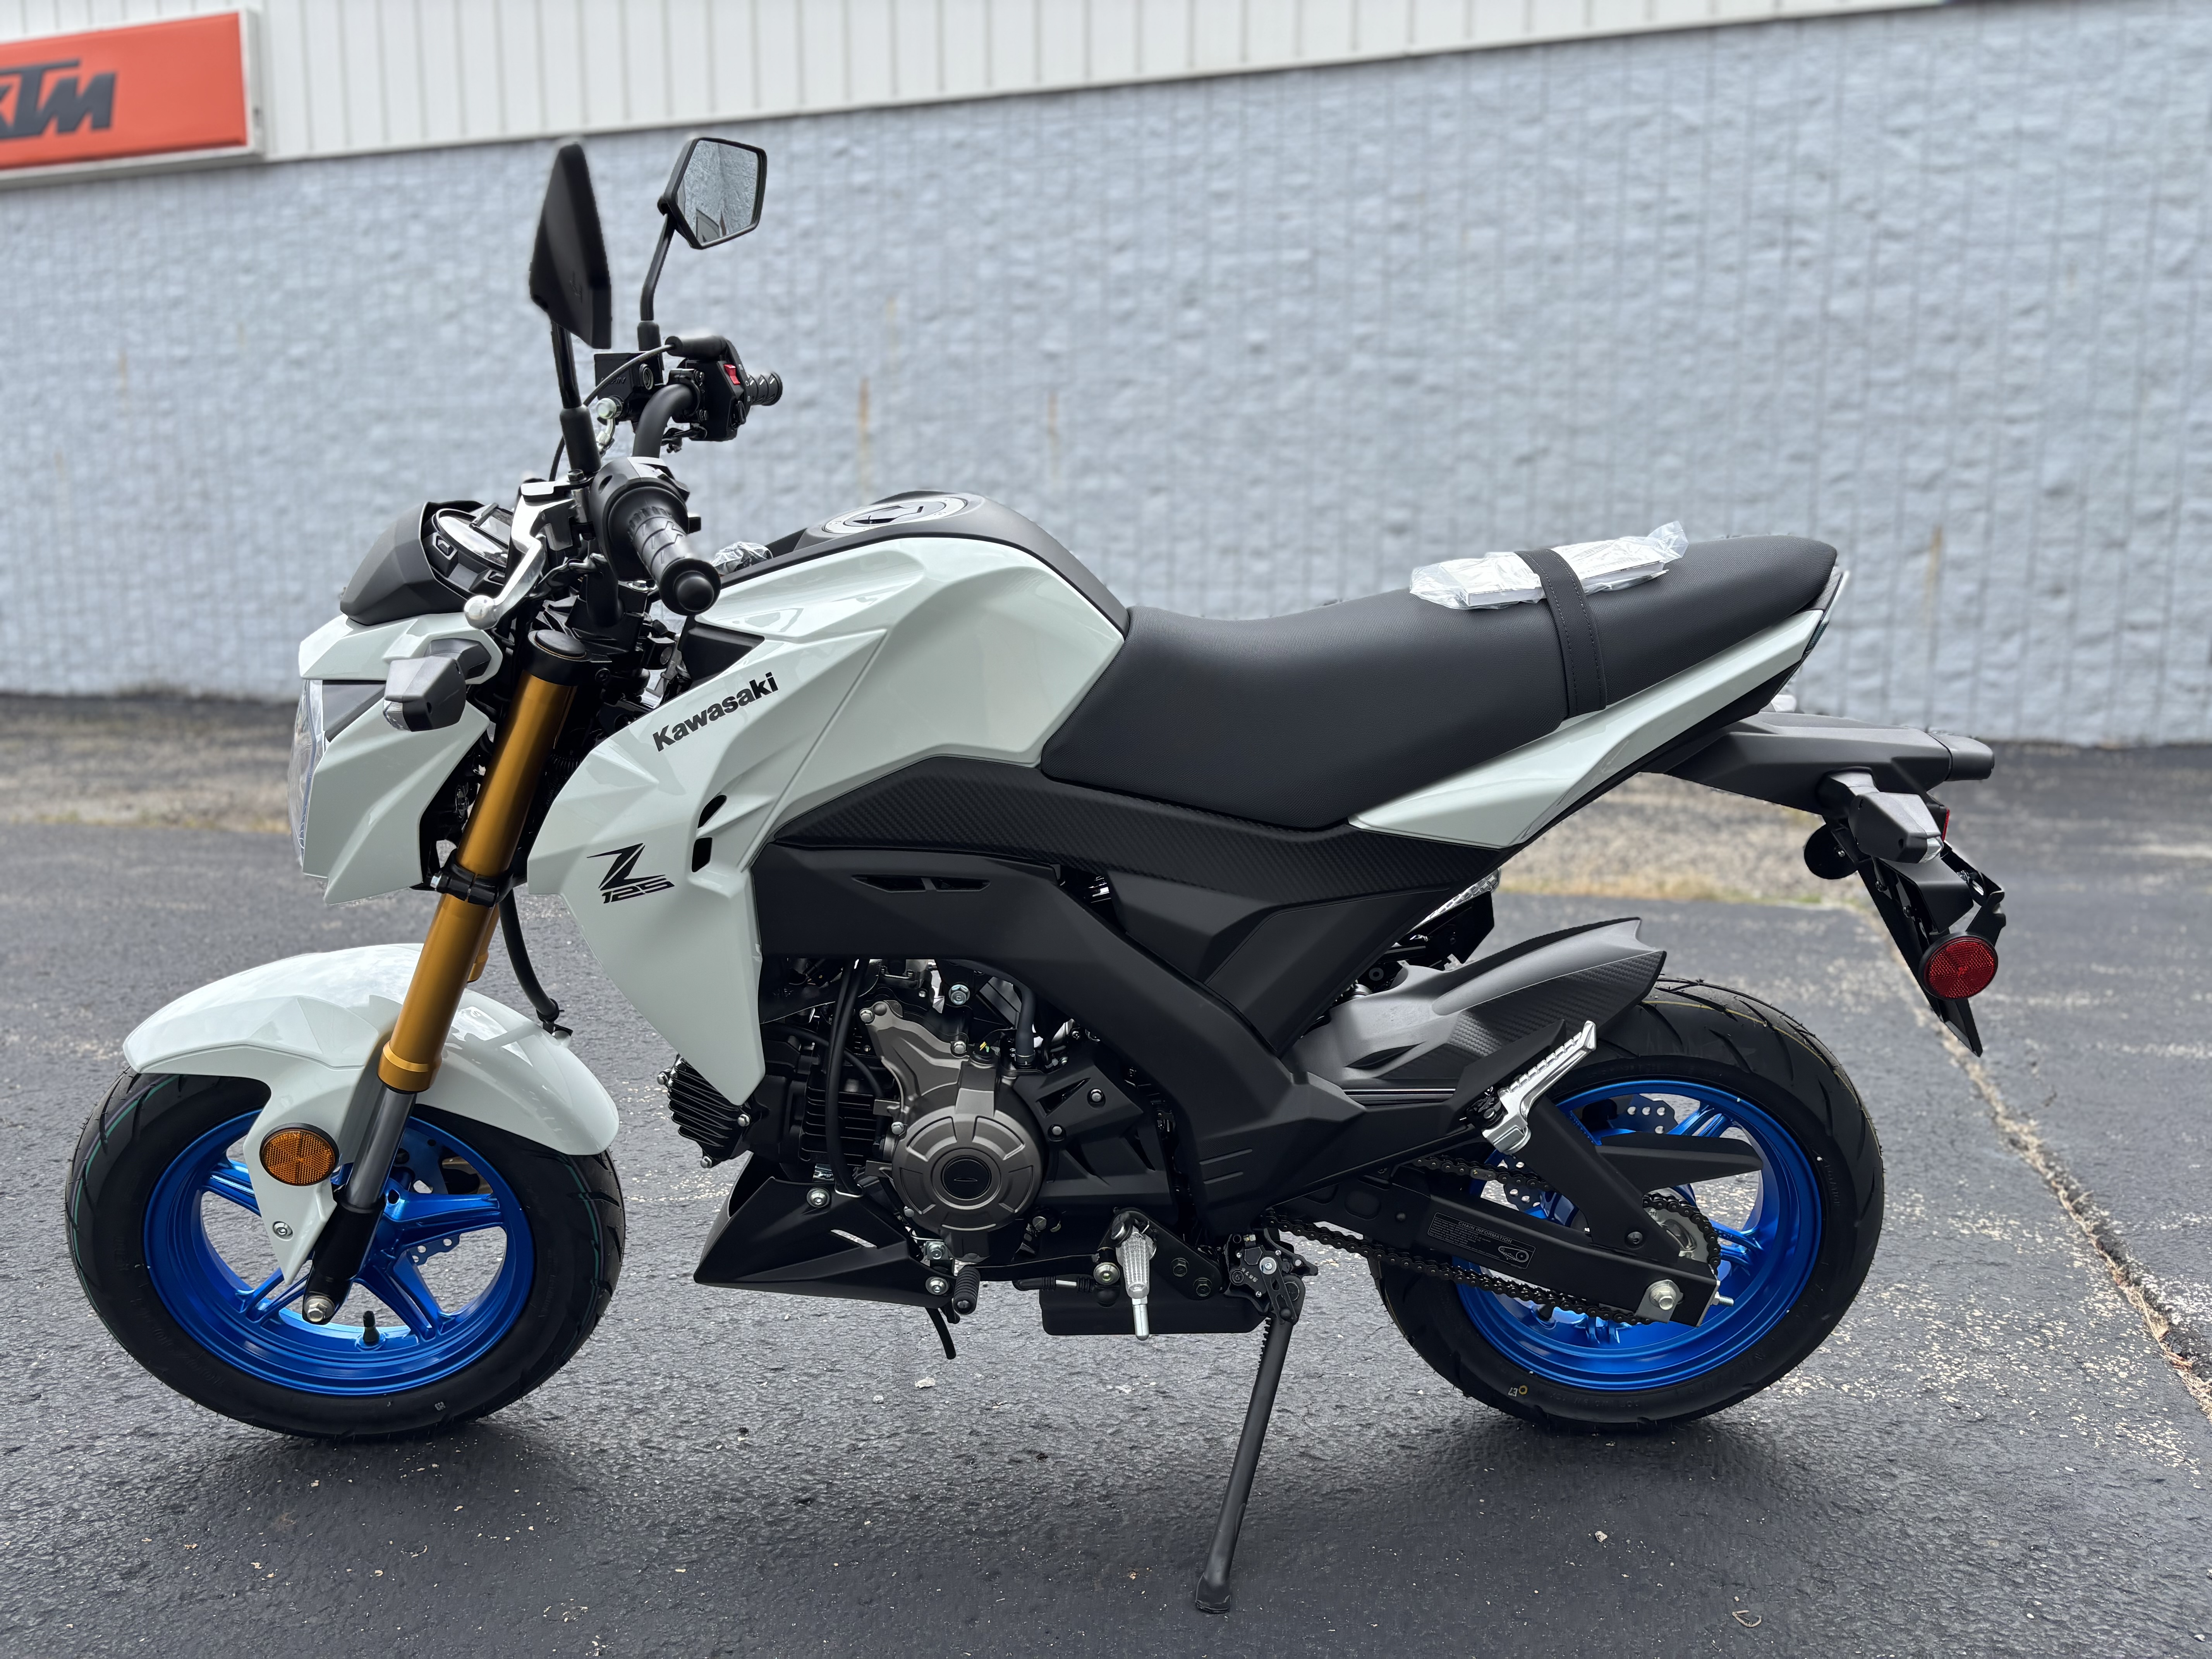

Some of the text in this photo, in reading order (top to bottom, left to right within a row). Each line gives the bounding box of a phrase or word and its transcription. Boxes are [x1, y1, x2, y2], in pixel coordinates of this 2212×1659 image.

[0, 58, 117, 140] TM
[653, 672, 778, 752] Kawasaki
[586, 843, 666, 890] Z
[601, 878, 675, 904] 125
[1458, 1221, 1475, 1231] CHAIN
[1475, 1227, 1512, 1243] INFORMATION
